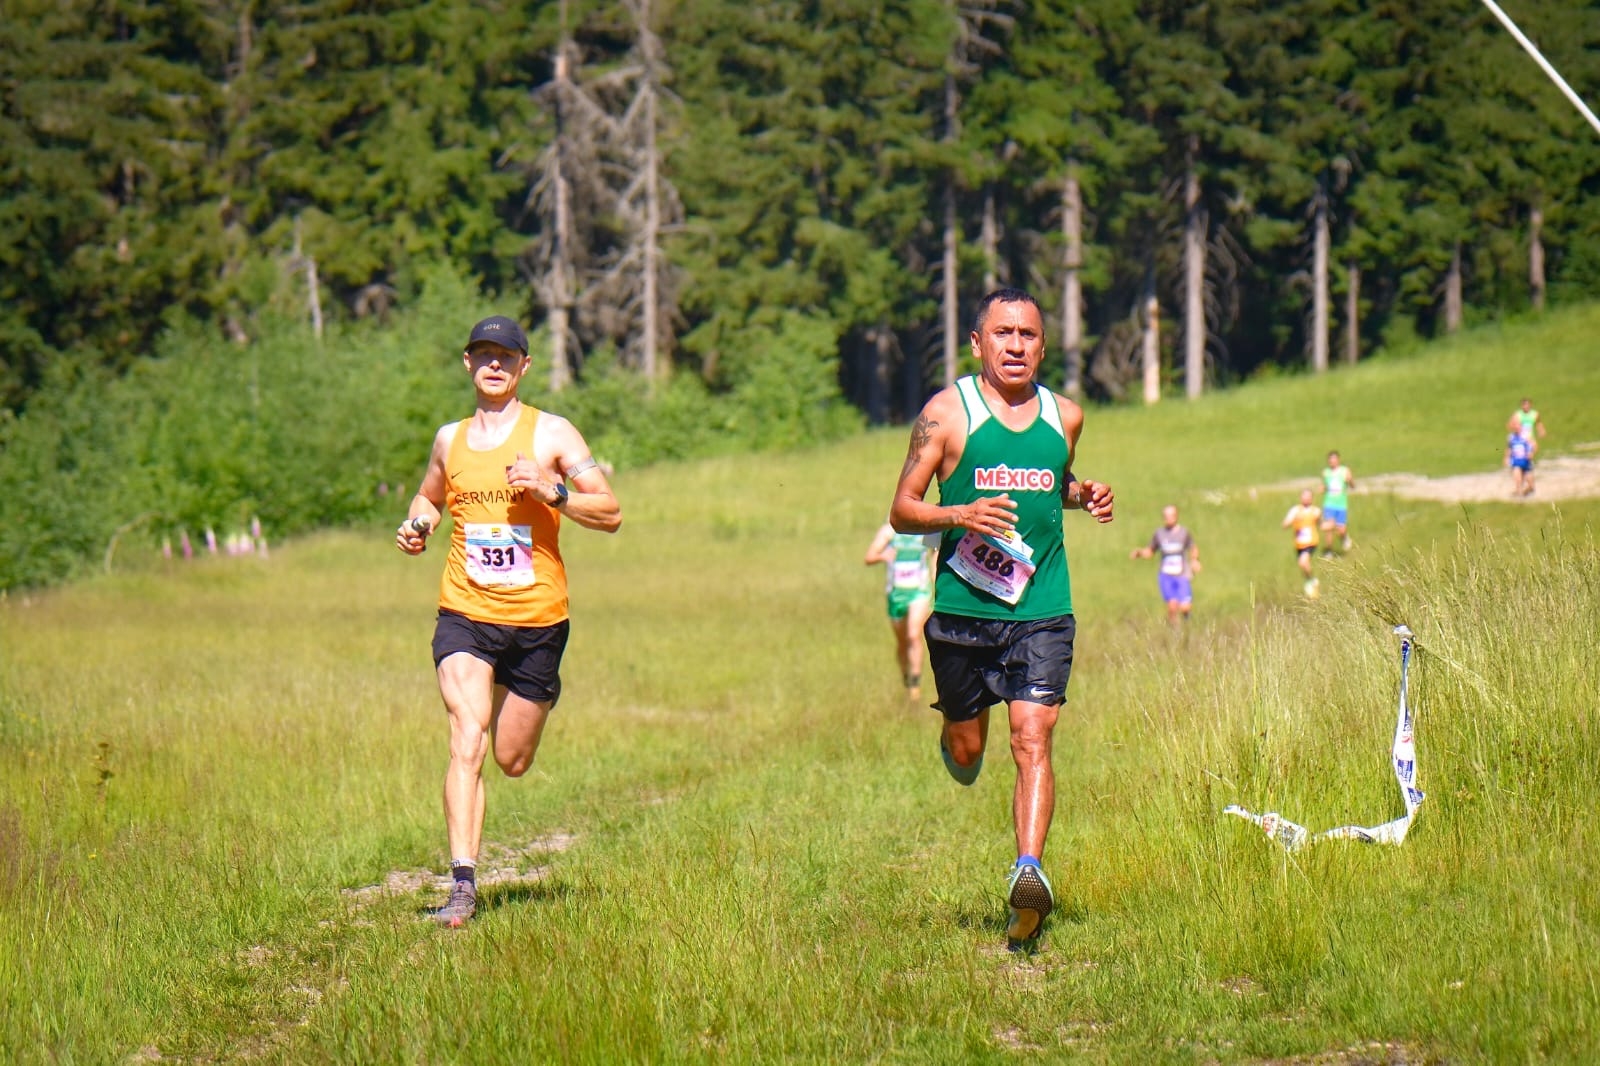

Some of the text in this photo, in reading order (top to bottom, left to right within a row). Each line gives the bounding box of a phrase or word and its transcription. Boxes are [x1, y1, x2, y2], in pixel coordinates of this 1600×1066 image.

[976, 464, 1054, 490] MÉXICO
[454, 486, 527, 506] GERMANY
[481, 546, 515, 567] 531
[971, 543, 1017, 577] 486
